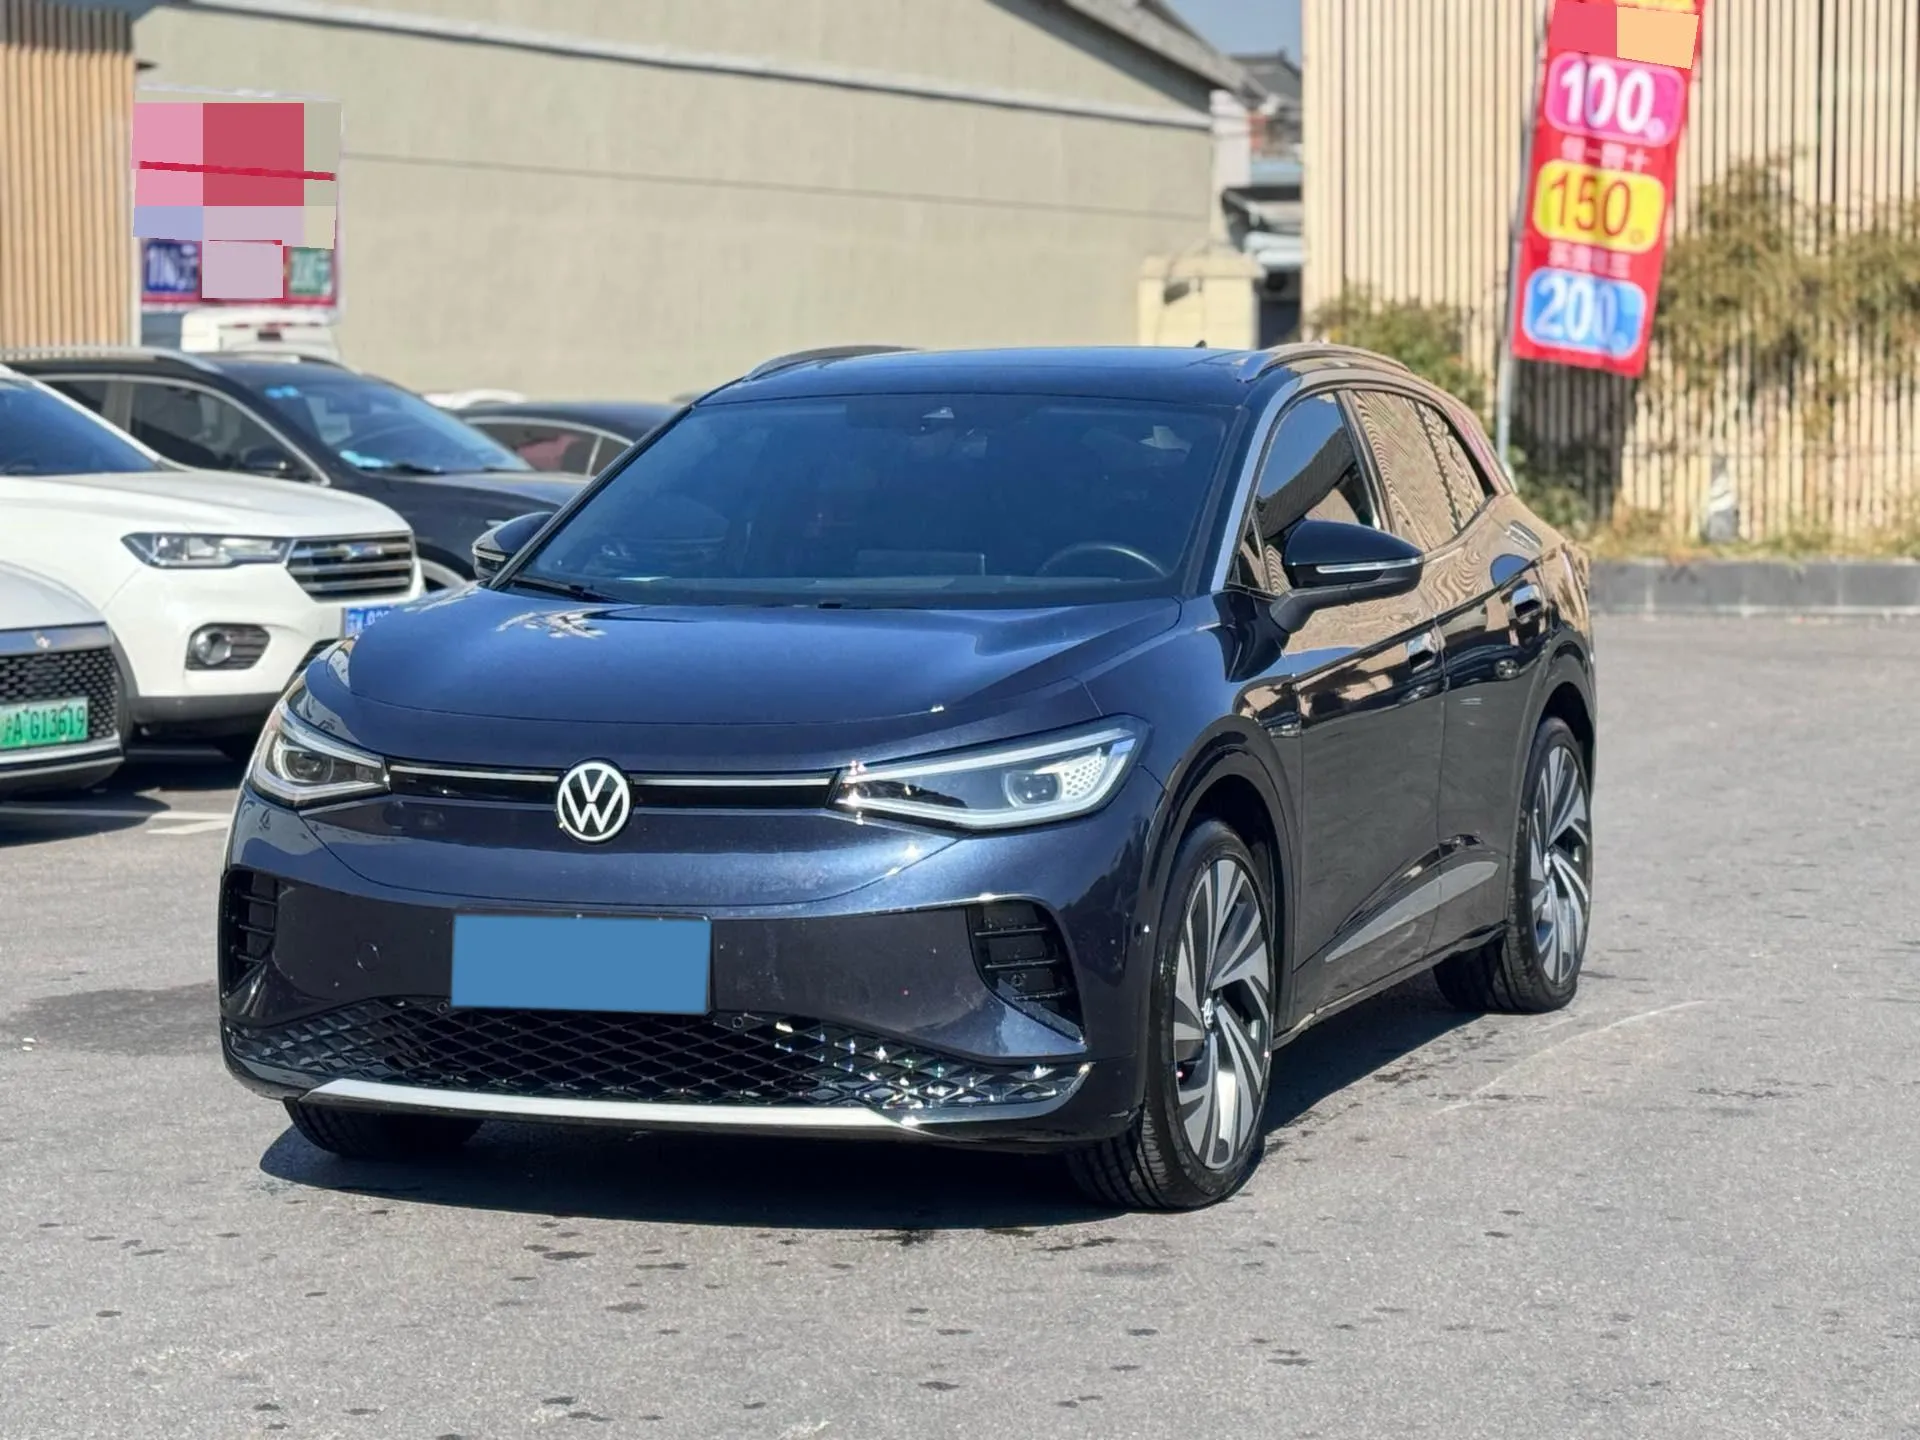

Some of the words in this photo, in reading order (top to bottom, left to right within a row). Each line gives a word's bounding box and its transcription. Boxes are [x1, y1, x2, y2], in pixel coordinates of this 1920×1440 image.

[1561, 59, 1655, 133] 100
[1550, 170, 1632, 237] 150
[1535, 276, 1618, 343] 200
